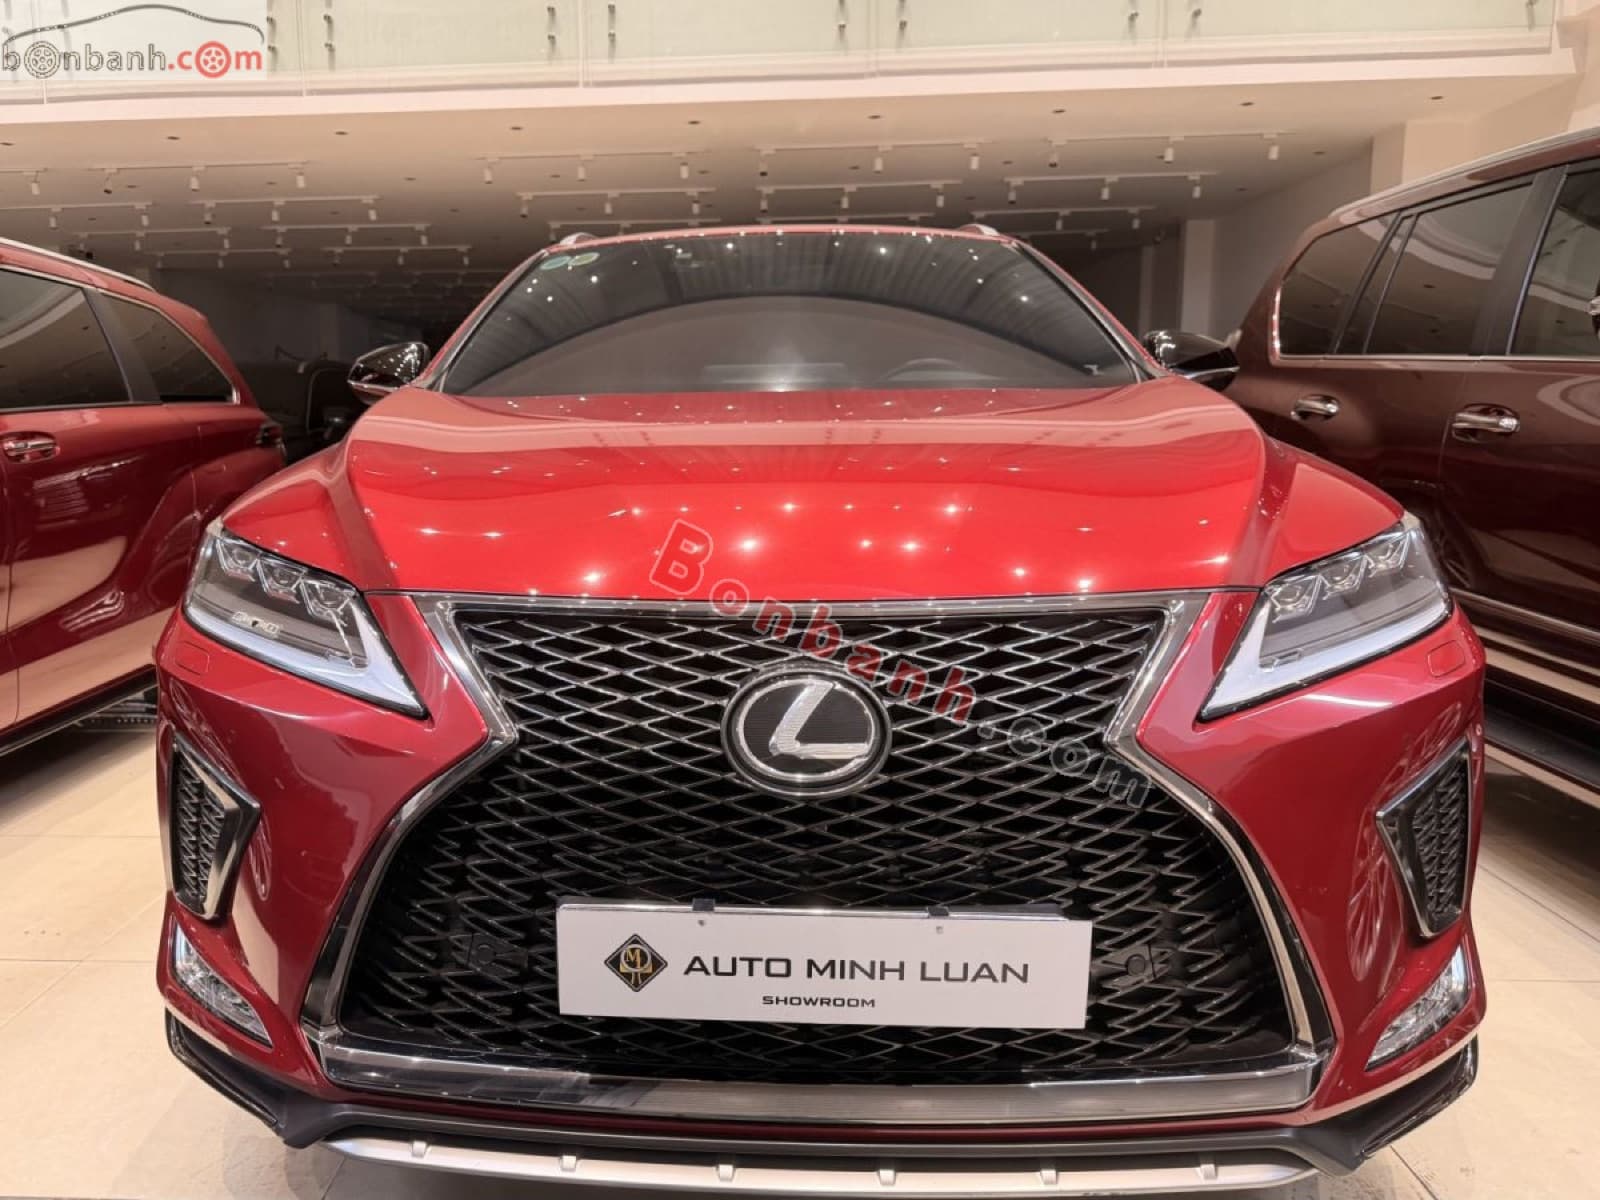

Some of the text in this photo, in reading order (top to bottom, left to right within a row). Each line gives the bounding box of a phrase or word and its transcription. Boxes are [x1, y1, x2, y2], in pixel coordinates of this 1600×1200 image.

[684, 955, 1029, 984] AUTO MINH LUAN
[762, 995, 876, 1008] SHOWROOM
